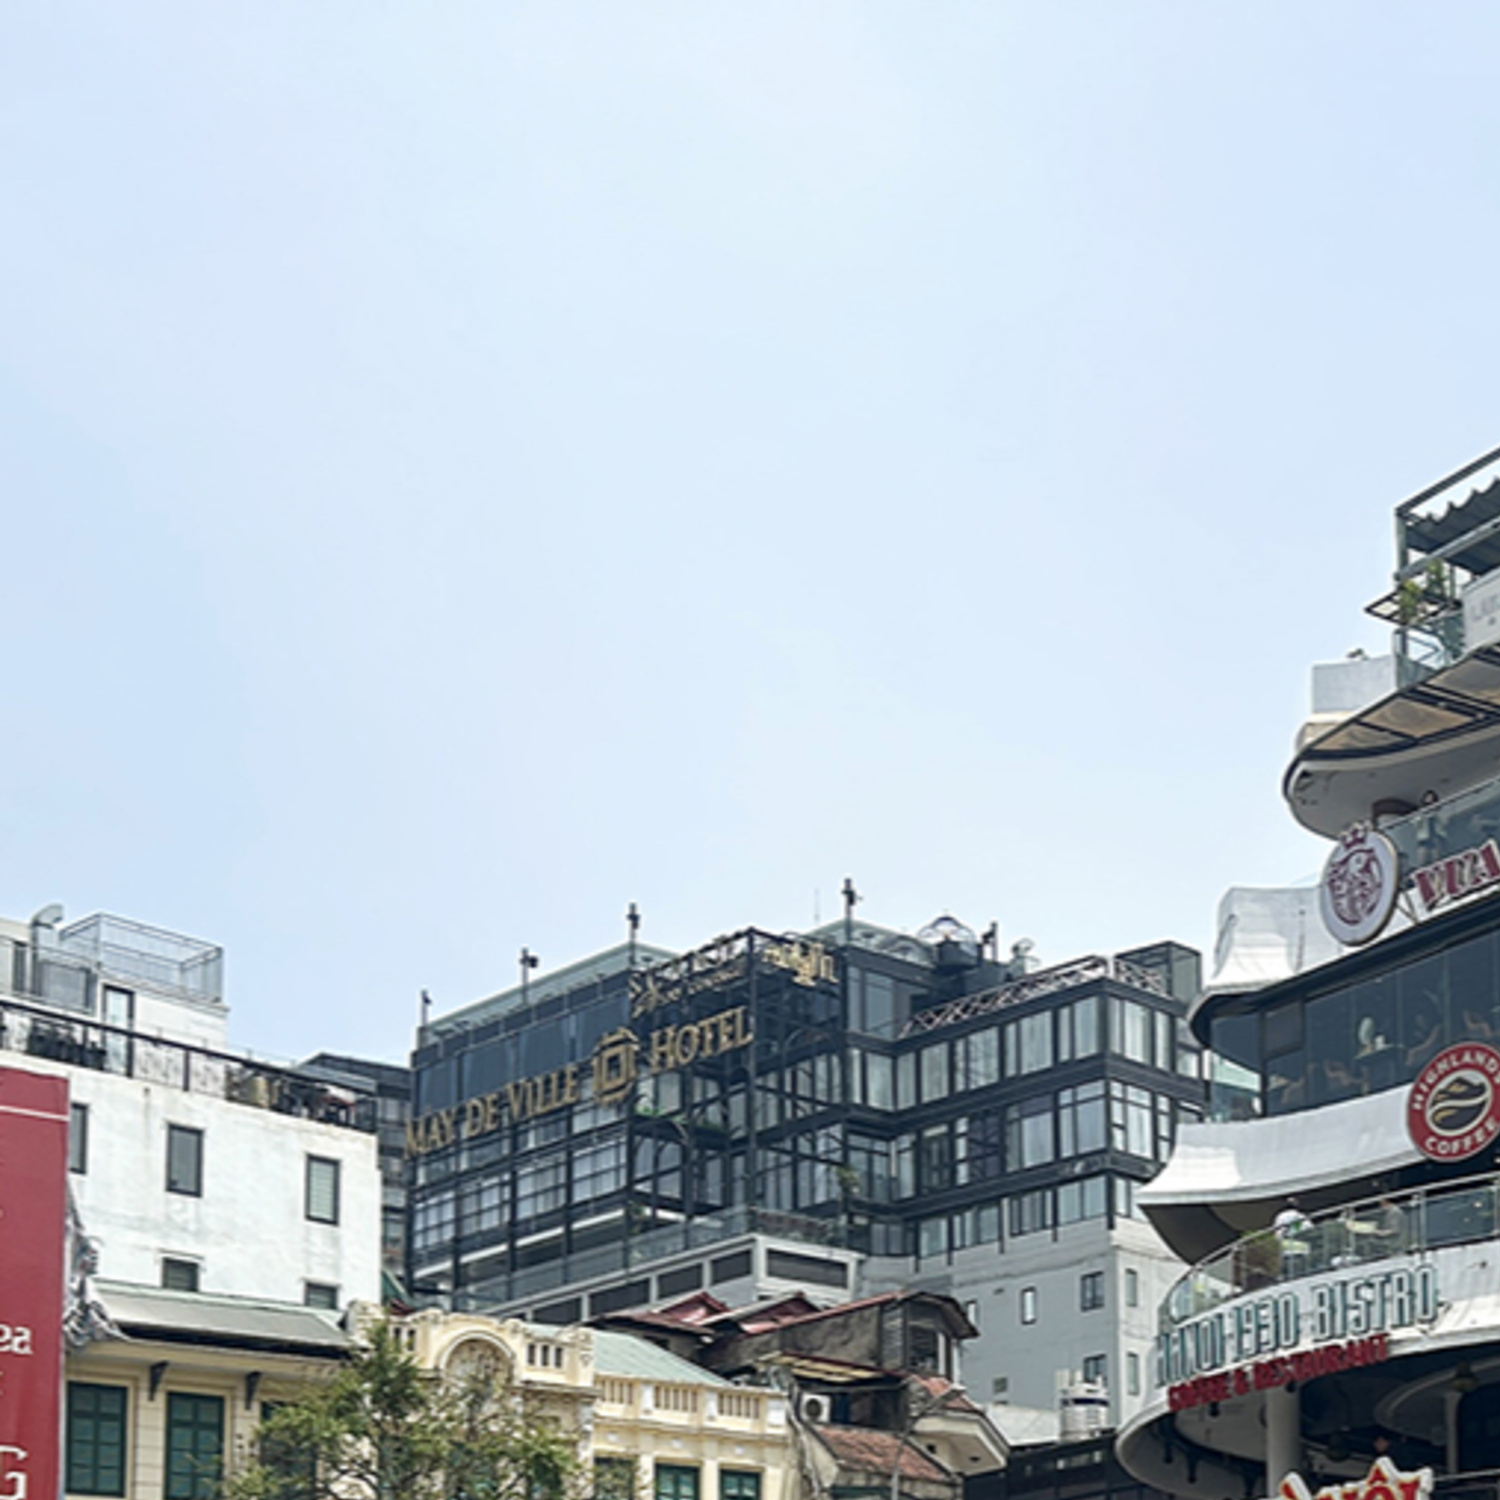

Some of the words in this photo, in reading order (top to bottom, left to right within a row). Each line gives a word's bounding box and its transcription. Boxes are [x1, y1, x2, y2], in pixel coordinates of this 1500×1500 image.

[404, 1107, 458, 1160] MAY
[466, 1092, 503, 1138] DE
[506, 1065, 580, 1122] VILLE
[651, 1006, 753, 1074] HOTEL
[1424, 1116, 1500, 1155] COFFEE
[1233, 1292, 1300, 1362] 1930
[1311, 1264, 1438, 1342] BISTRO
